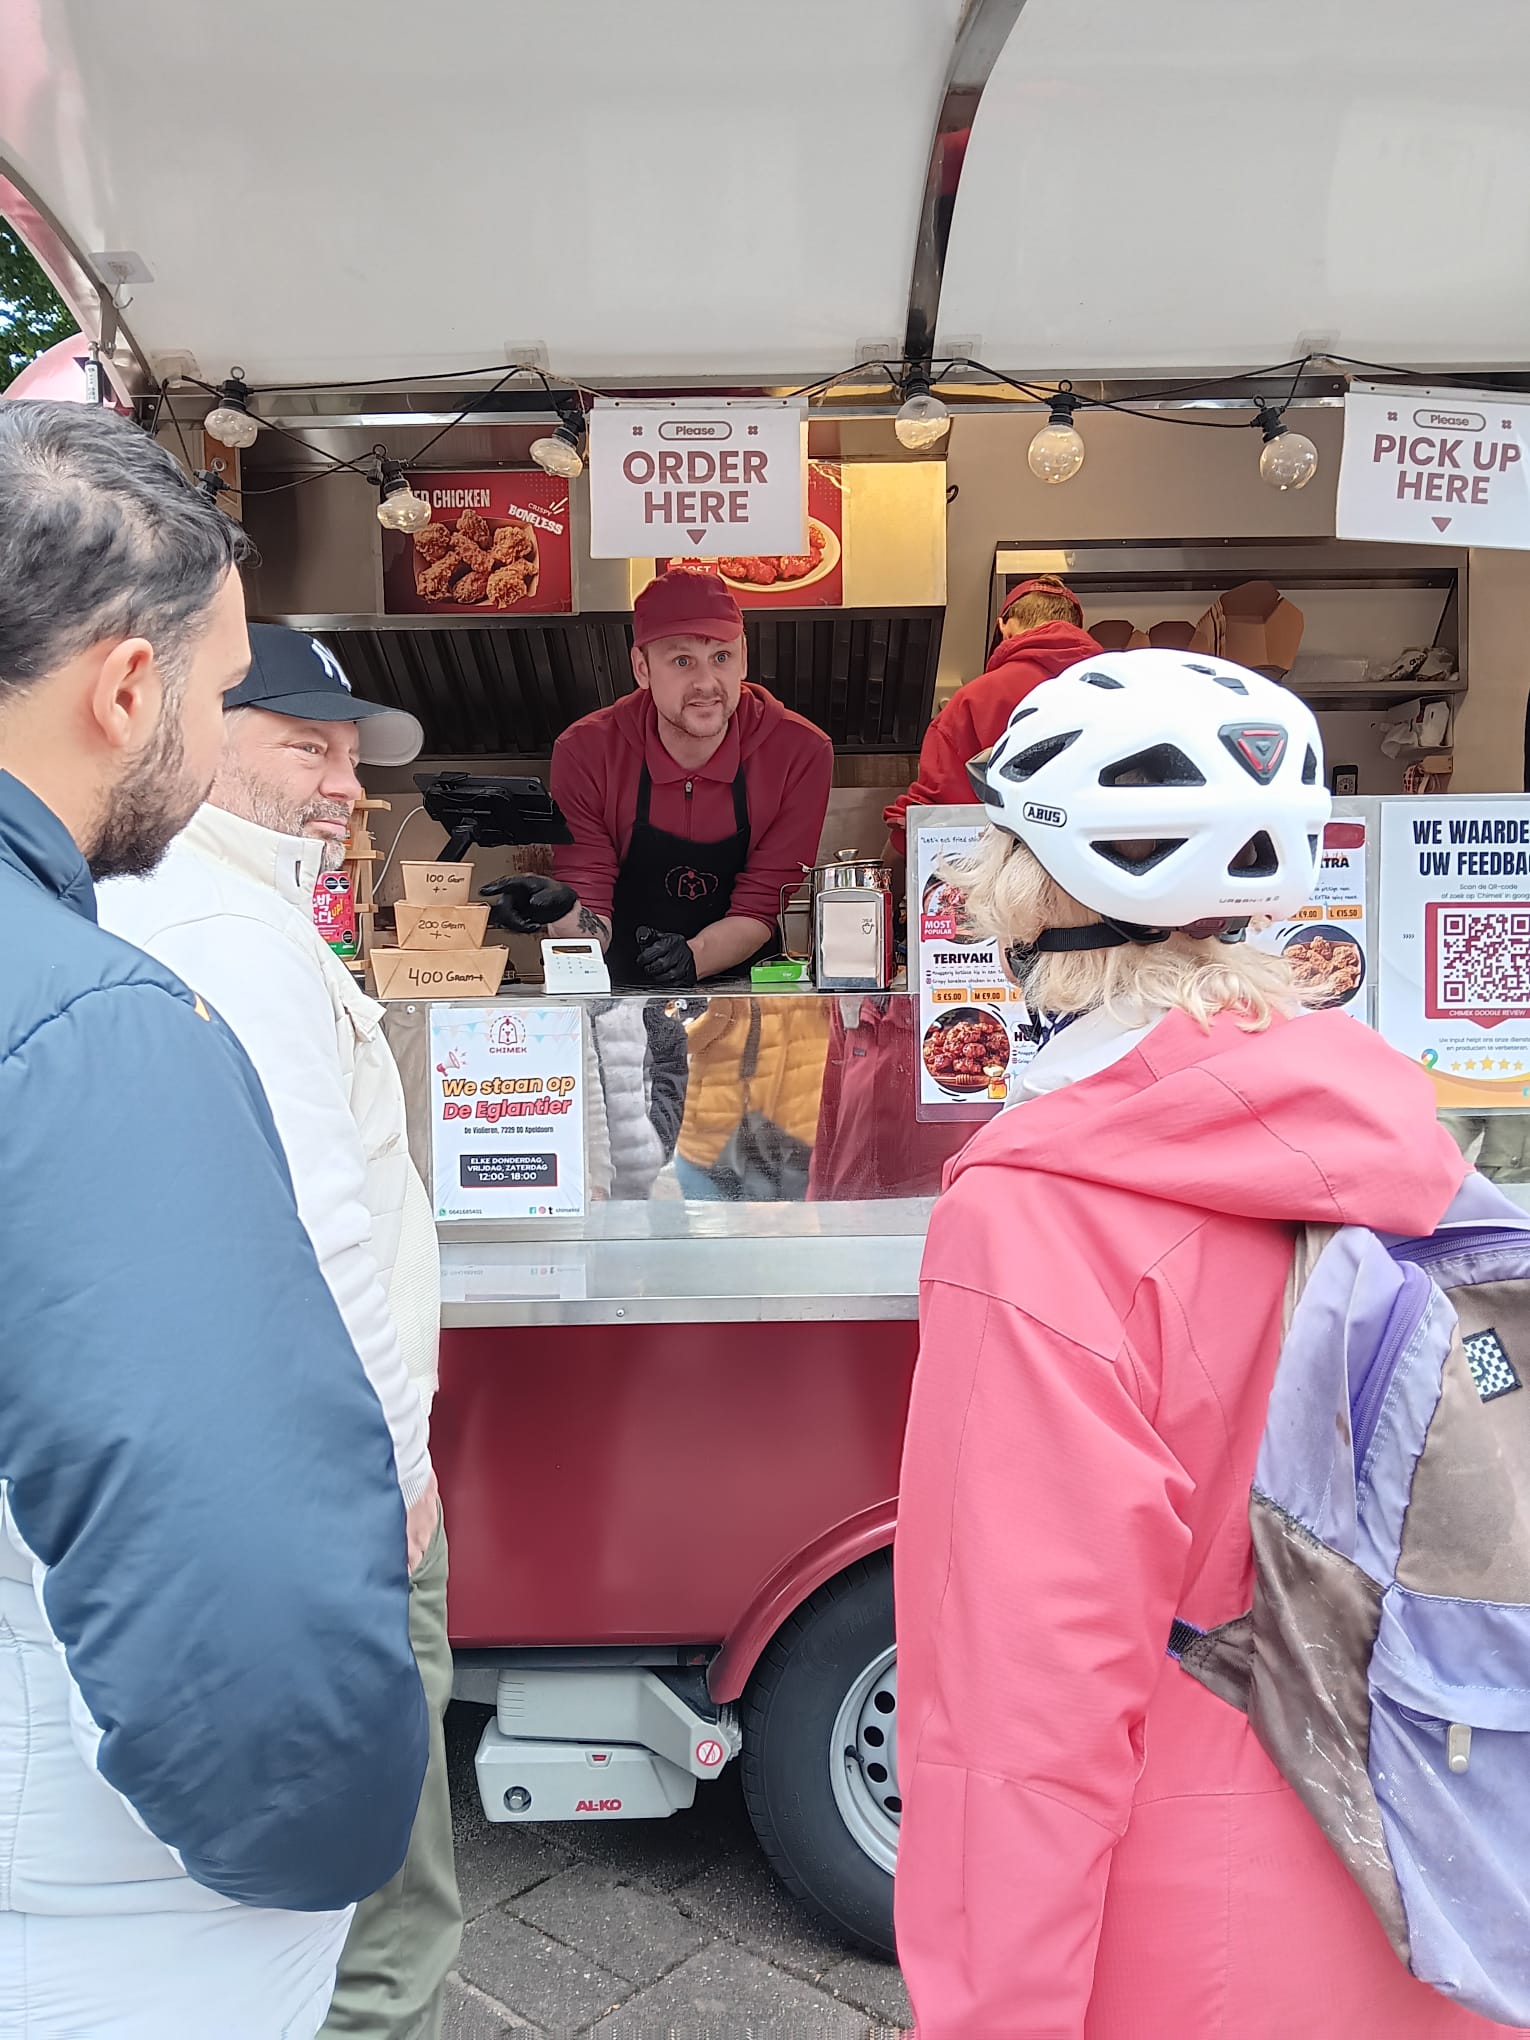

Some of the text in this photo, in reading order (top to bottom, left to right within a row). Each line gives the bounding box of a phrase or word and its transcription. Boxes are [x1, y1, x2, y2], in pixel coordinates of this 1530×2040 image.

[1430, 414, 1469, 426] Please
[675, 425, 715, 436] Please
[1373, 433, 1521, 472] PICK UP
[622, 450, 768, 484] ORDER
[1397, 470, 1490, 505] HERE
[433, 489, 491, 508] CHICKEN
[644, 490, 749, 524] HERE
[528, 502, 552, 516] CRISPY
[508, 504, 564, 535] BONELESS
[1027, 806, 1061, 823] ABUS
[1413, 820, 1442, 844] WE
[1420, 852, 1530, 876] UW FEEDBA
[426, 873, 444, 883] 100
[1337, 909, 1358, 917] €15.50
[418, 920, 465, 930] 200 Gram
[925, 920, 951, 929] MOST
[933, 953, 993, 964] TERIYAKI
[409, 968, 443, 986] 400
[442, 1076, 575, 1097] We staan op
[443, 1096, 573, 1123] De Eglantier
[470, 1157, 491, 1165] ELKE
[511, 1172, 537, 1180] 18:00
[575, 1799, 622, 1812] AL-KO
